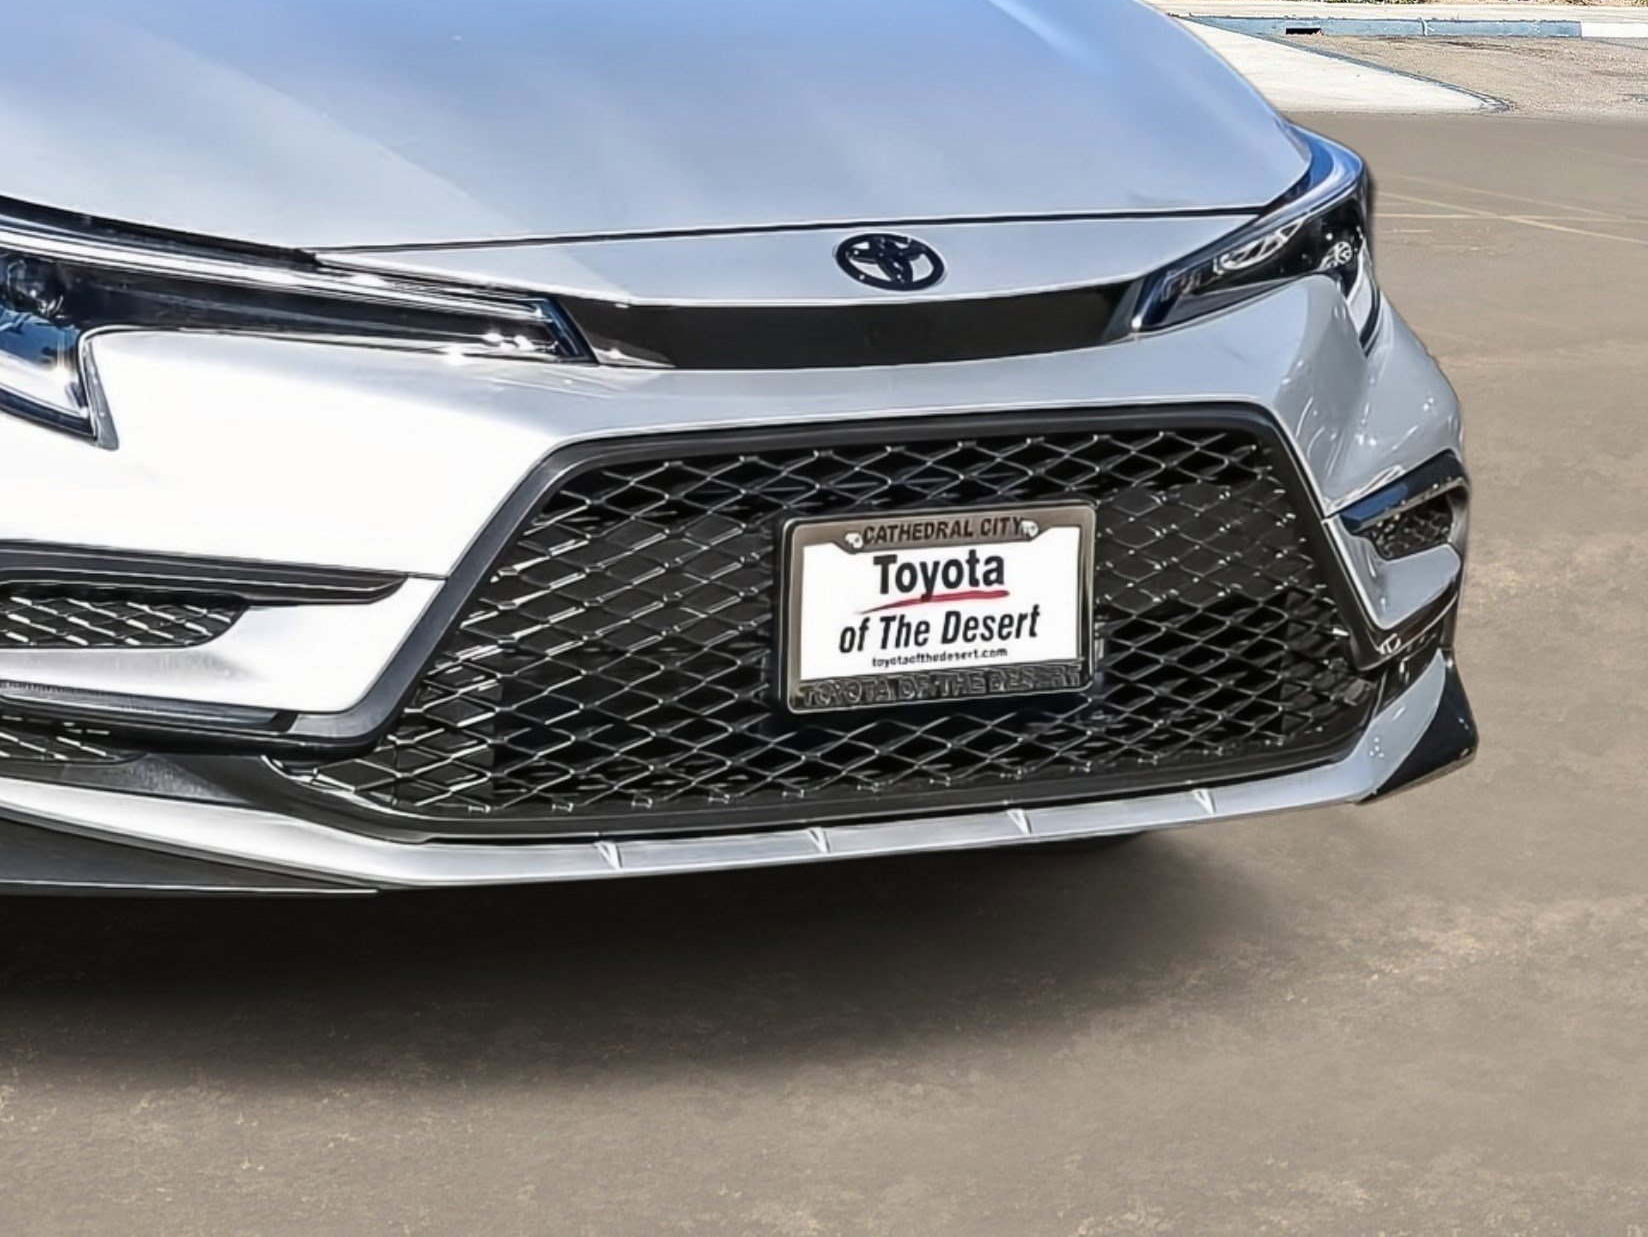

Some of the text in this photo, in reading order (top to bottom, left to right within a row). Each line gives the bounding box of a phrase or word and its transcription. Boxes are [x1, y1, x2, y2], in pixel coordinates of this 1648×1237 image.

[862, 516, 1024, 545] CATHEDRAL CITY
[873, 549, 1005, 601] Toyota
[839, 604, 1040, 653] of The Desert
[872, 648, 1008, 668] toyotaofthedesert.com
[801, 674, 896, 707] TOYOTA
[934, 668, 986, 697] THE
